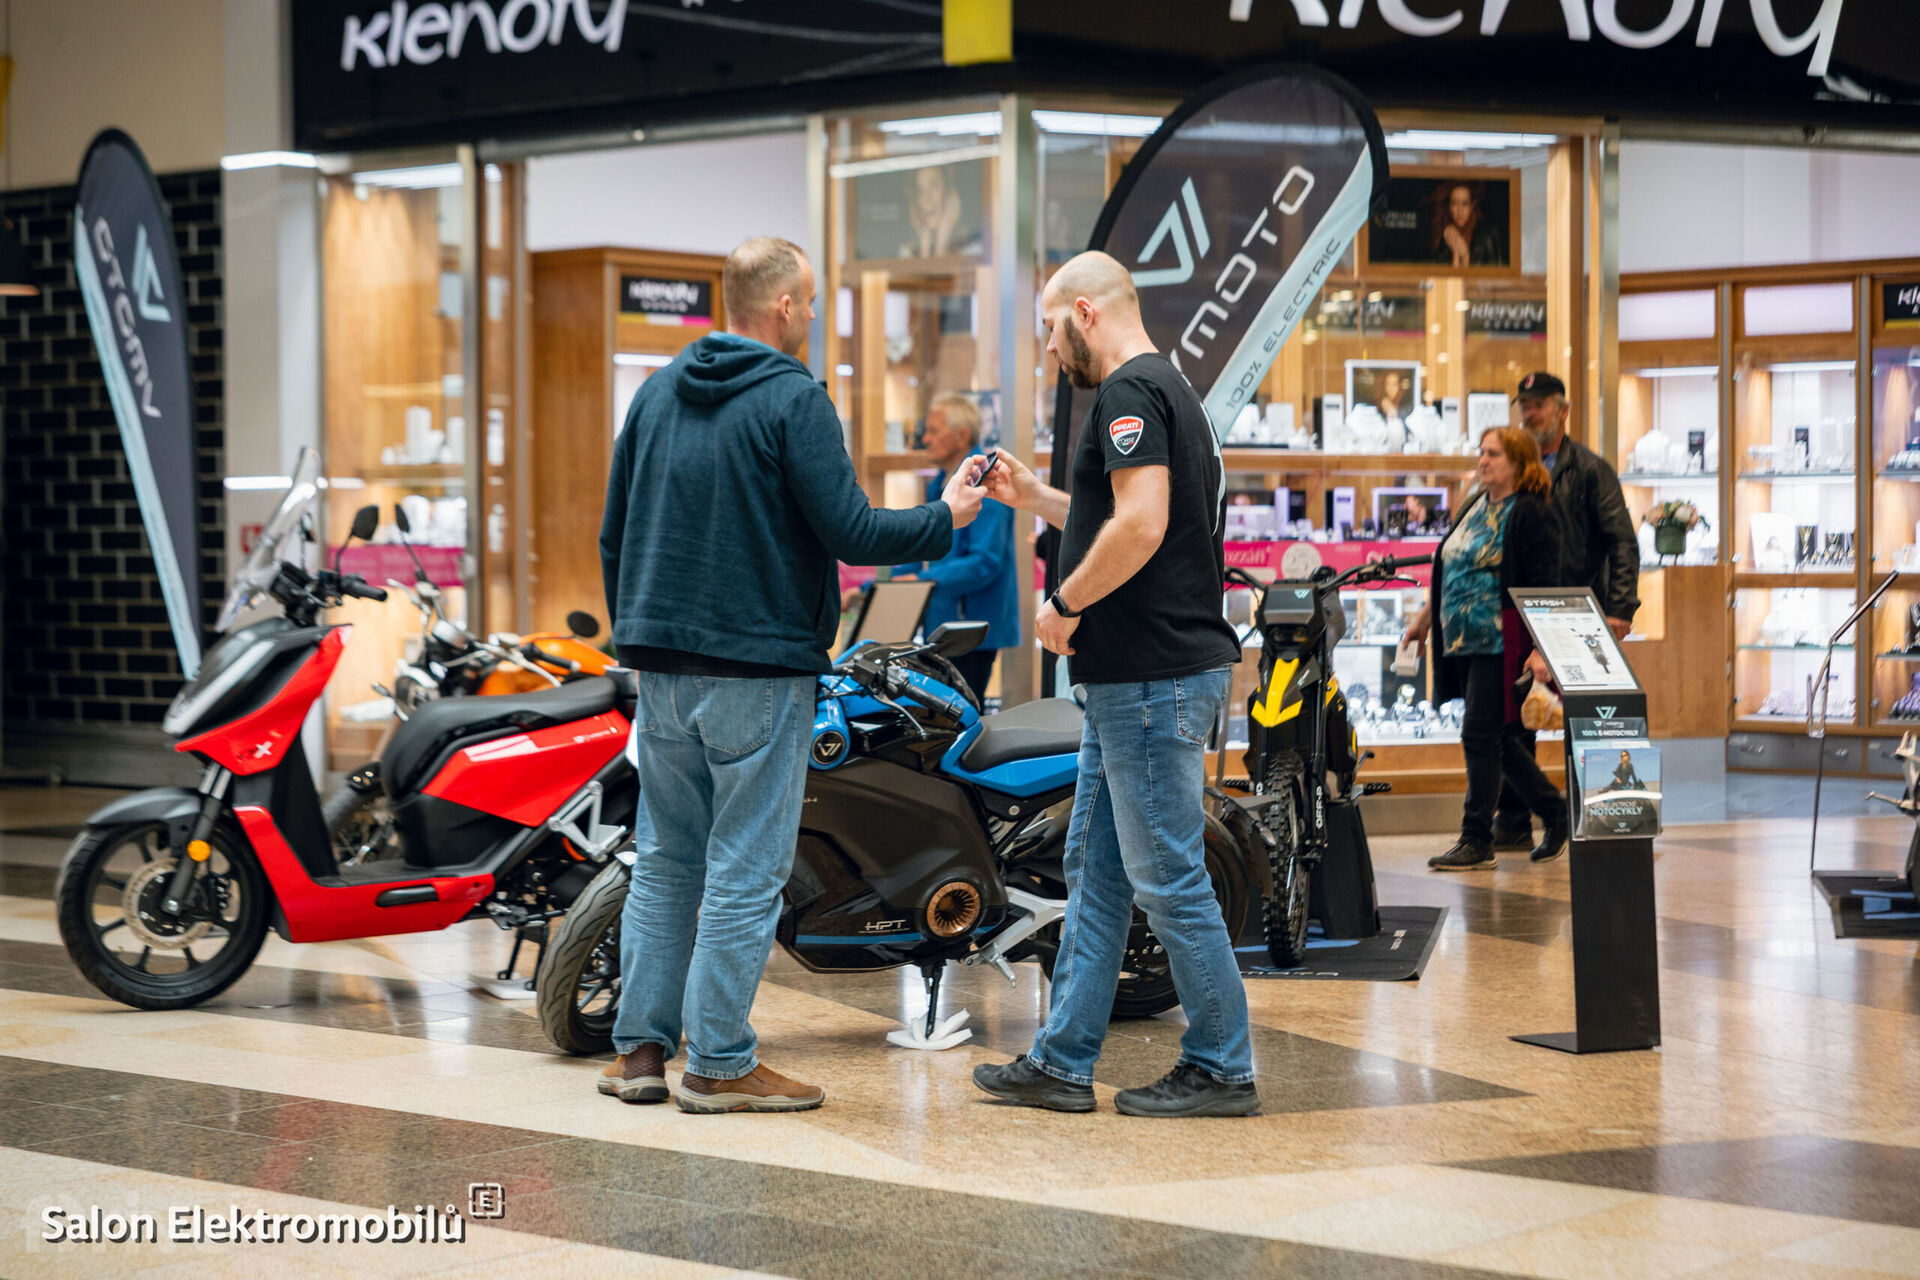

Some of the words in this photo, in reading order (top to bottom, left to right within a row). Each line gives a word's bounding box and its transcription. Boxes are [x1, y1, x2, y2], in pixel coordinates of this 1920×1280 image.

[1225, 362, 1262, 410] 100%
[1263, 238, 1341, 353] ELECTRIC
[1113, 421, 1139, 432] DUCATI
[1590, 806, 1643, 816] MOTOCYKLY
[865, 919, 906, 930] HPT
